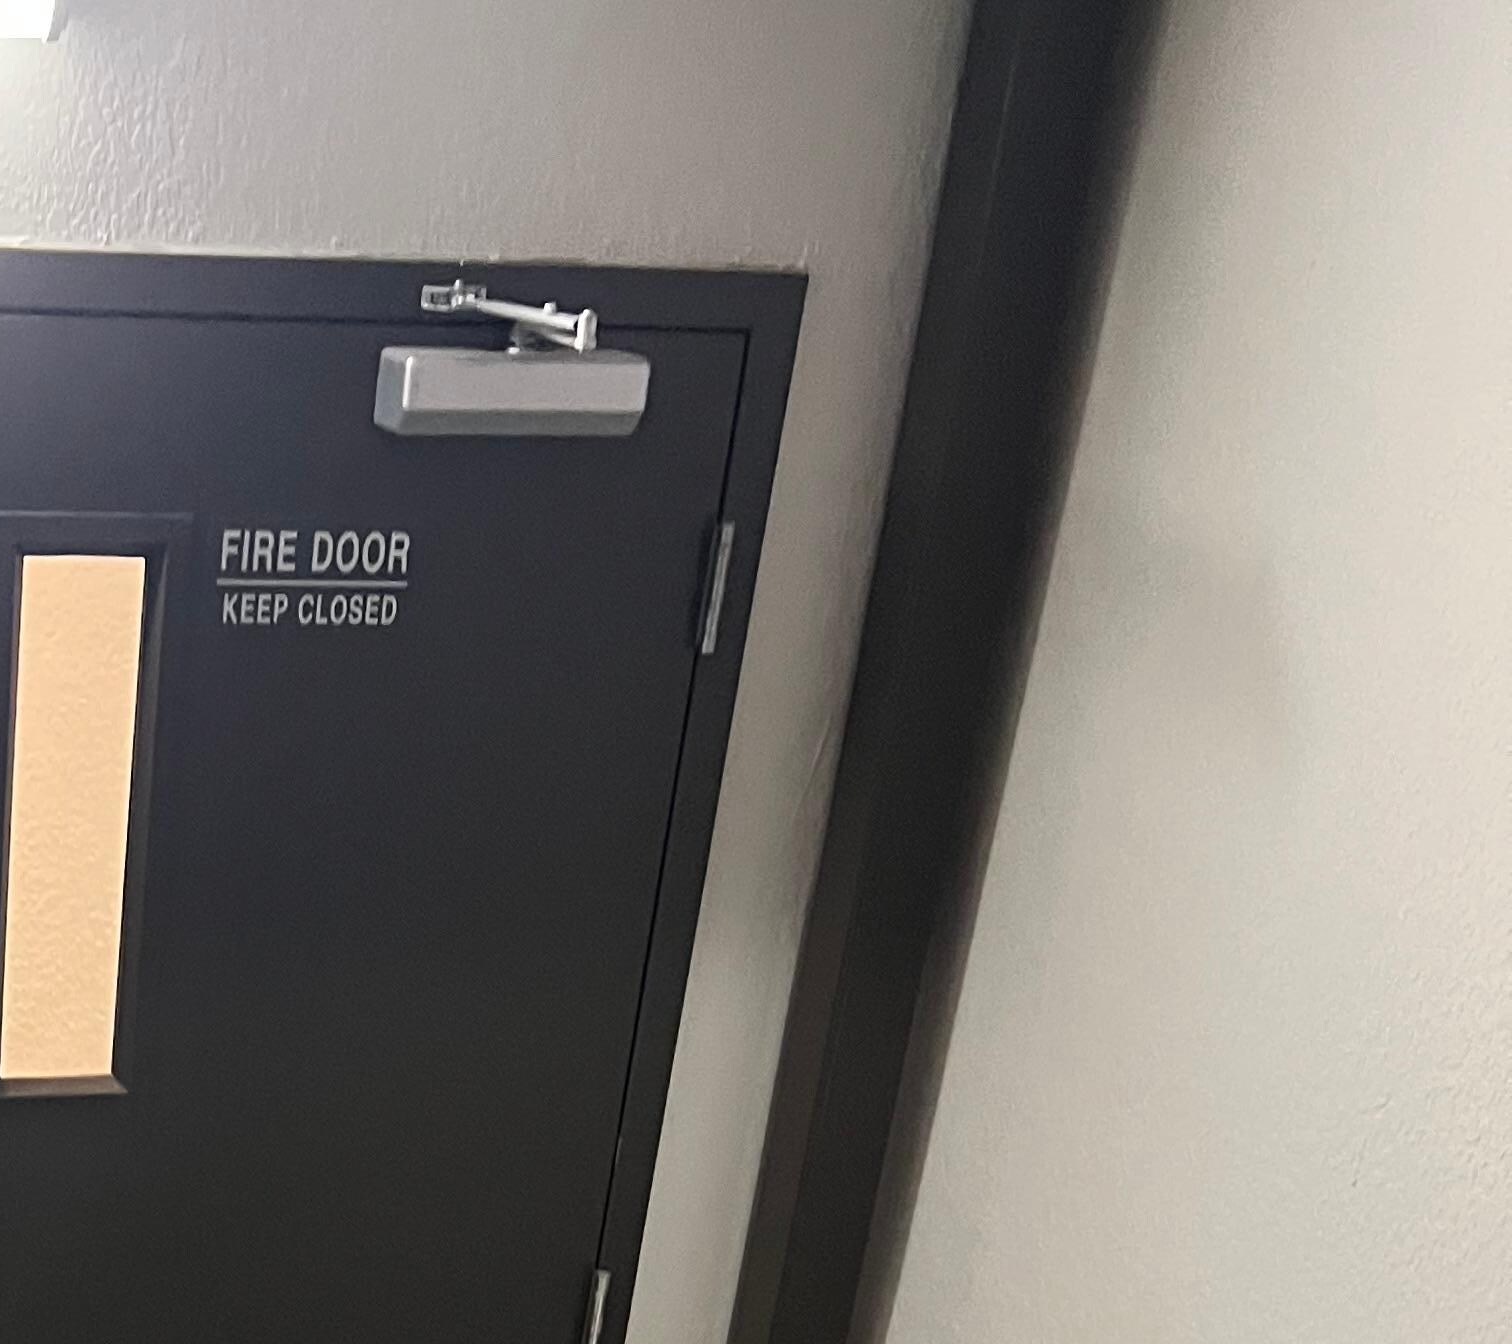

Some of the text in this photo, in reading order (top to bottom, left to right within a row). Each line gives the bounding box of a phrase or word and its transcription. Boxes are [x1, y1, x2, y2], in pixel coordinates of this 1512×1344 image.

[220, 529, 411, 574] FIRE DOOR
[222, 592, 397, 626] KEEP CLOSED
